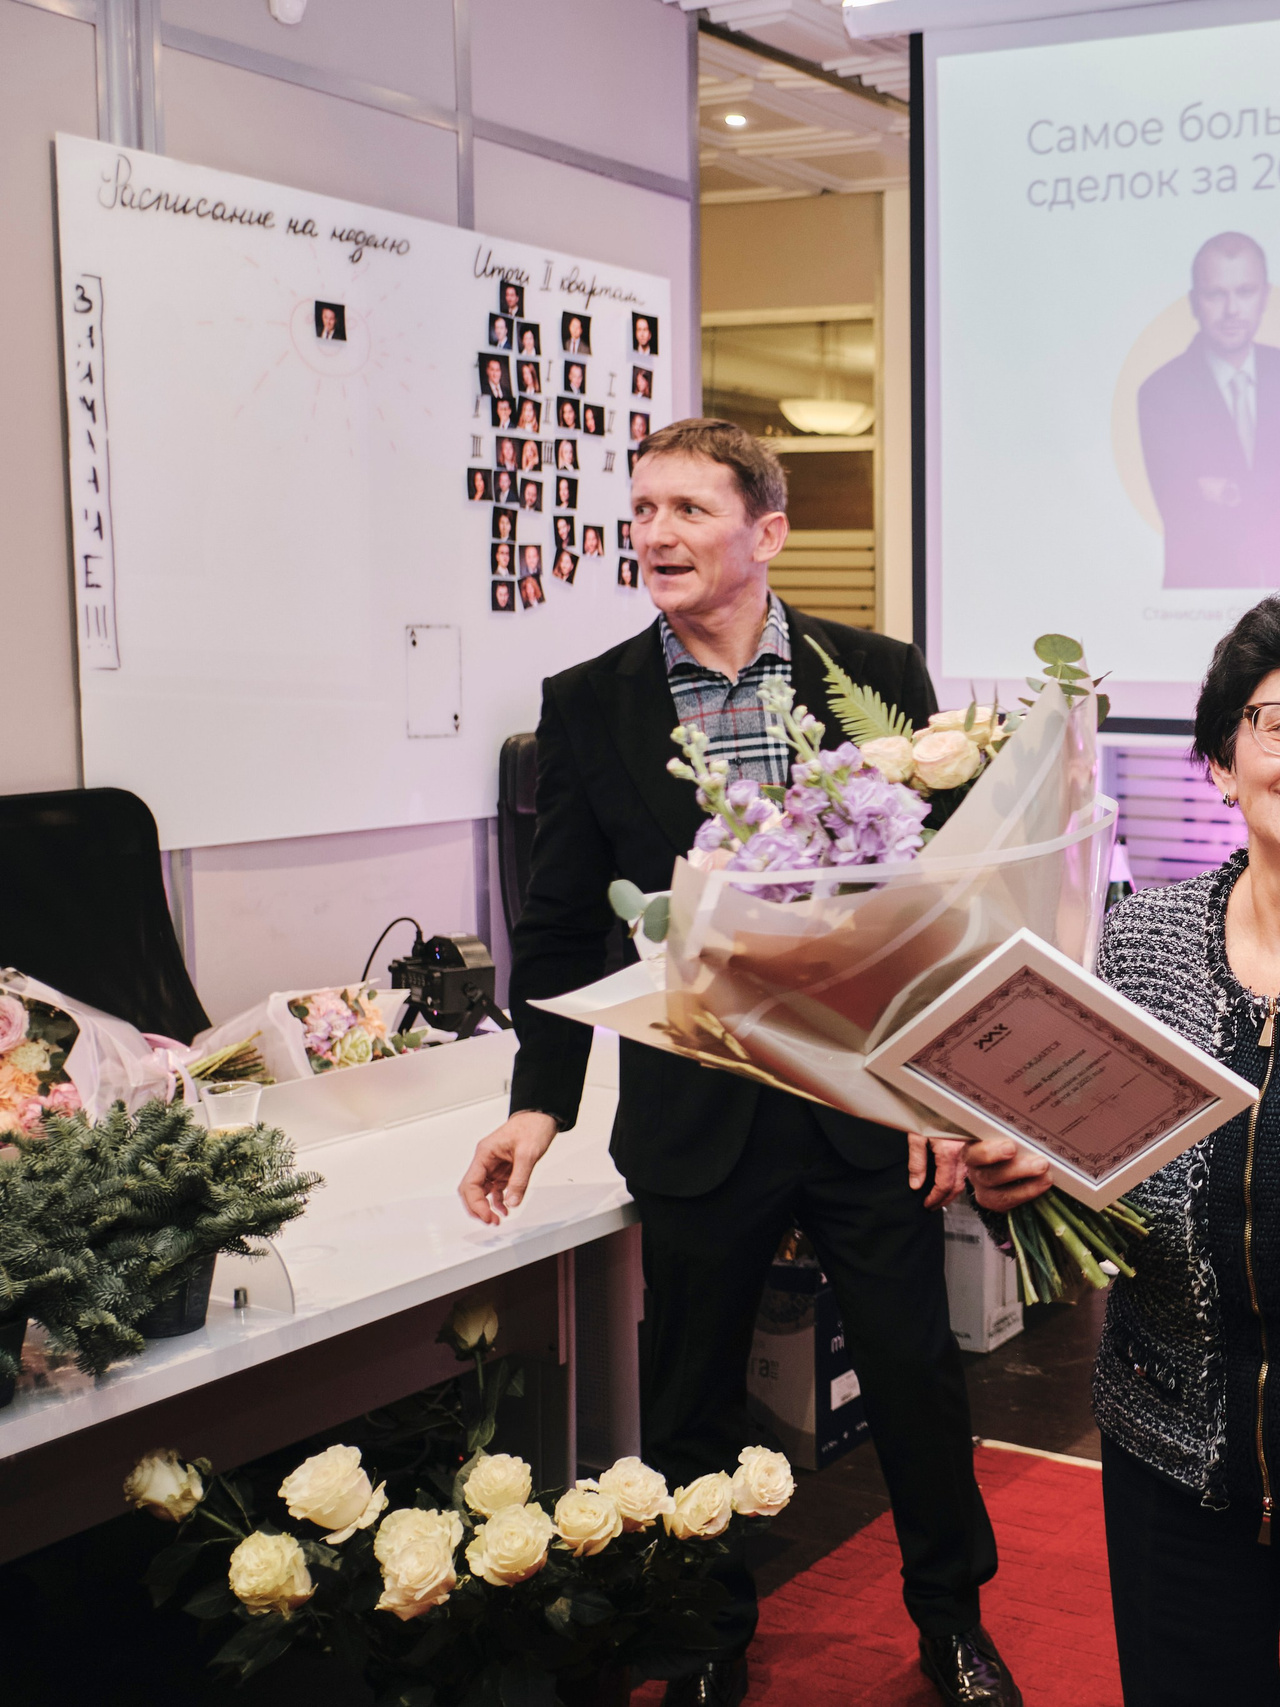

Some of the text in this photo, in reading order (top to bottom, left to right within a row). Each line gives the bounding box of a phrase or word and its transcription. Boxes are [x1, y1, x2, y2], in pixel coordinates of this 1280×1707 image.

[1027, 119, 1164, 155] Самое
[99, 153, 275, 228] Расписание
[286, 217, 318, 238] на
[1027, 168, 1179, 212] сделок
[1191, 164, 1237, 195] за
